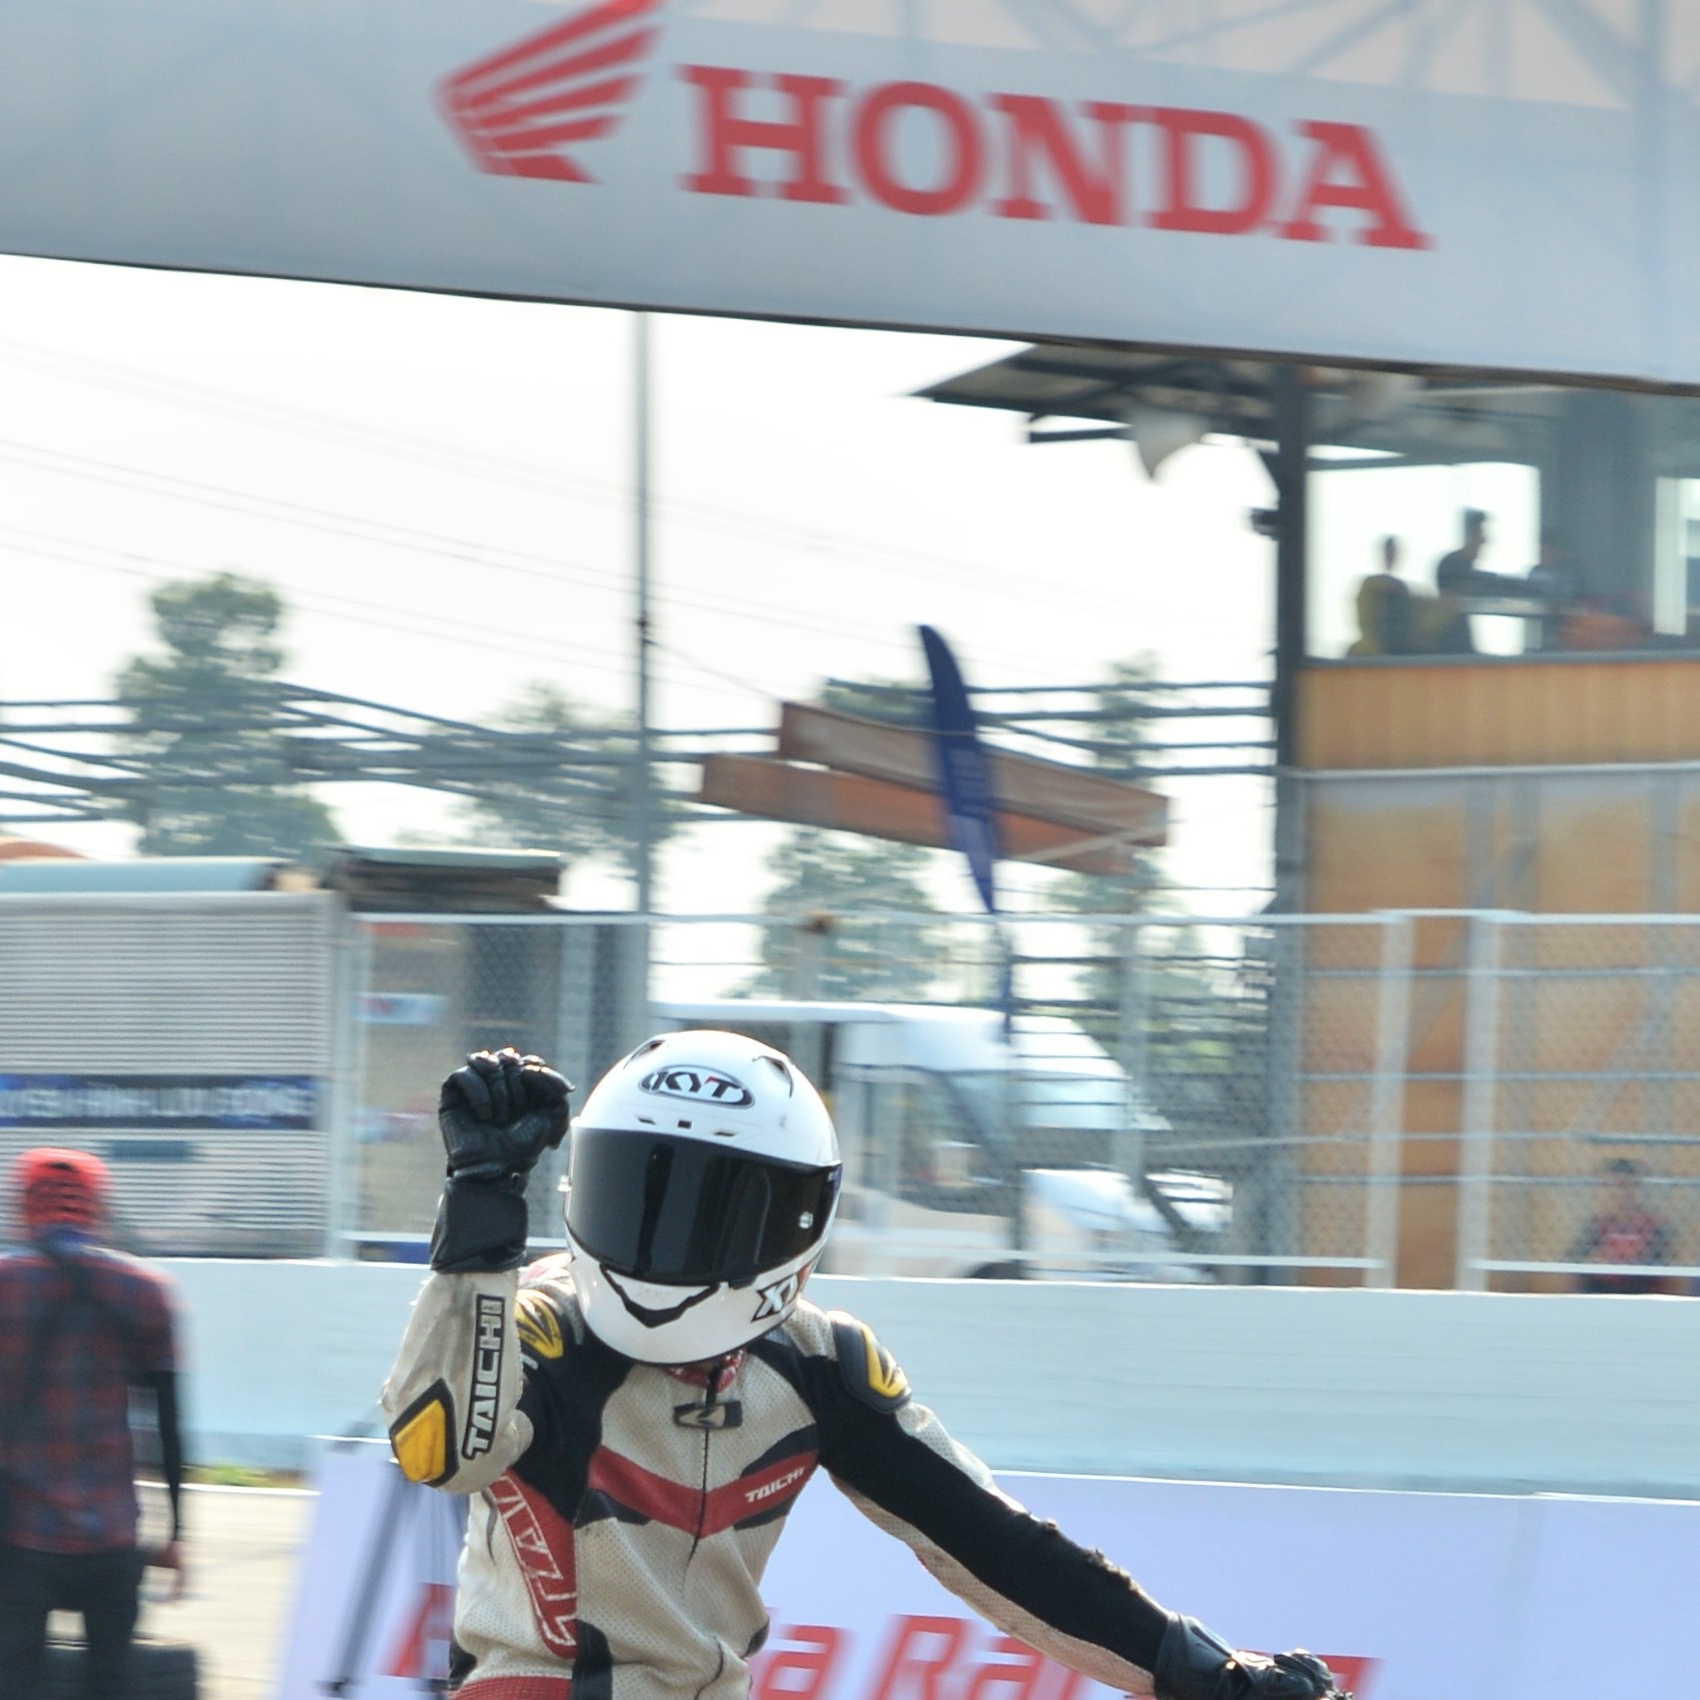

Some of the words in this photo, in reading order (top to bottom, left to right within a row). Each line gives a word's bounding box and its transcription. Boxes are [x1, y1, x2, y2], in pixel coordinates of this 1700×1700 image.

[676, 62, 1435, 252] HONDA
[648, 1069, 742, 1100] KYT
[462, 1294, 505, 1460] TAICHI
[745, 1466, 806, 1503] TAICHI
